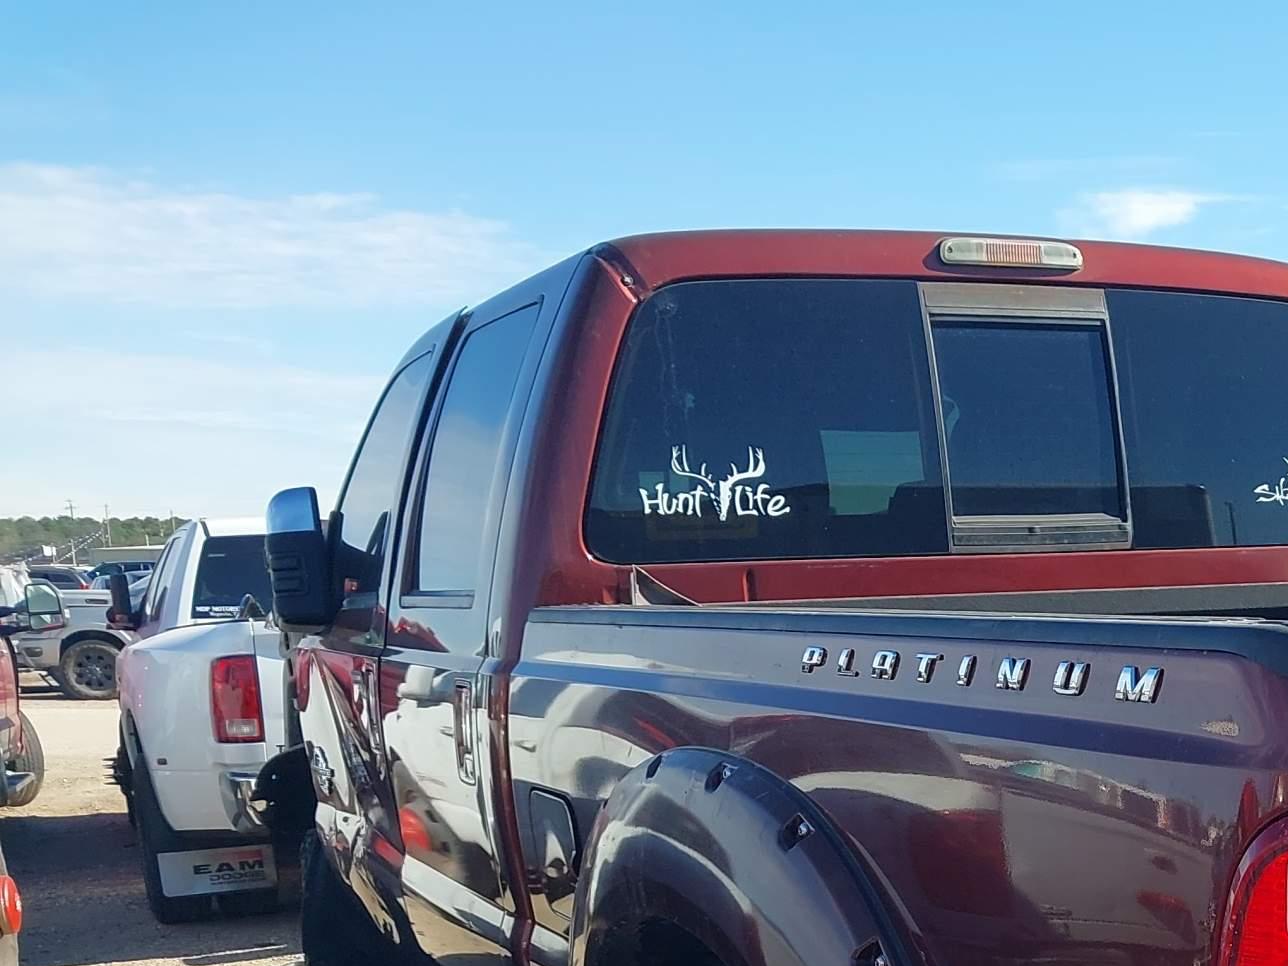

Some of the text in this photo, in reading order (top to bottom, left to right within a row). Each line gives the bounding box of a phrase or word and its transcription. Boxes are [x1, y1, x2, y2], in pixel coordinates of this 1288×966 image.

[639, 483, 790, 518] Hunt Life
[801, 645, 1165, 703] PLATINUM
